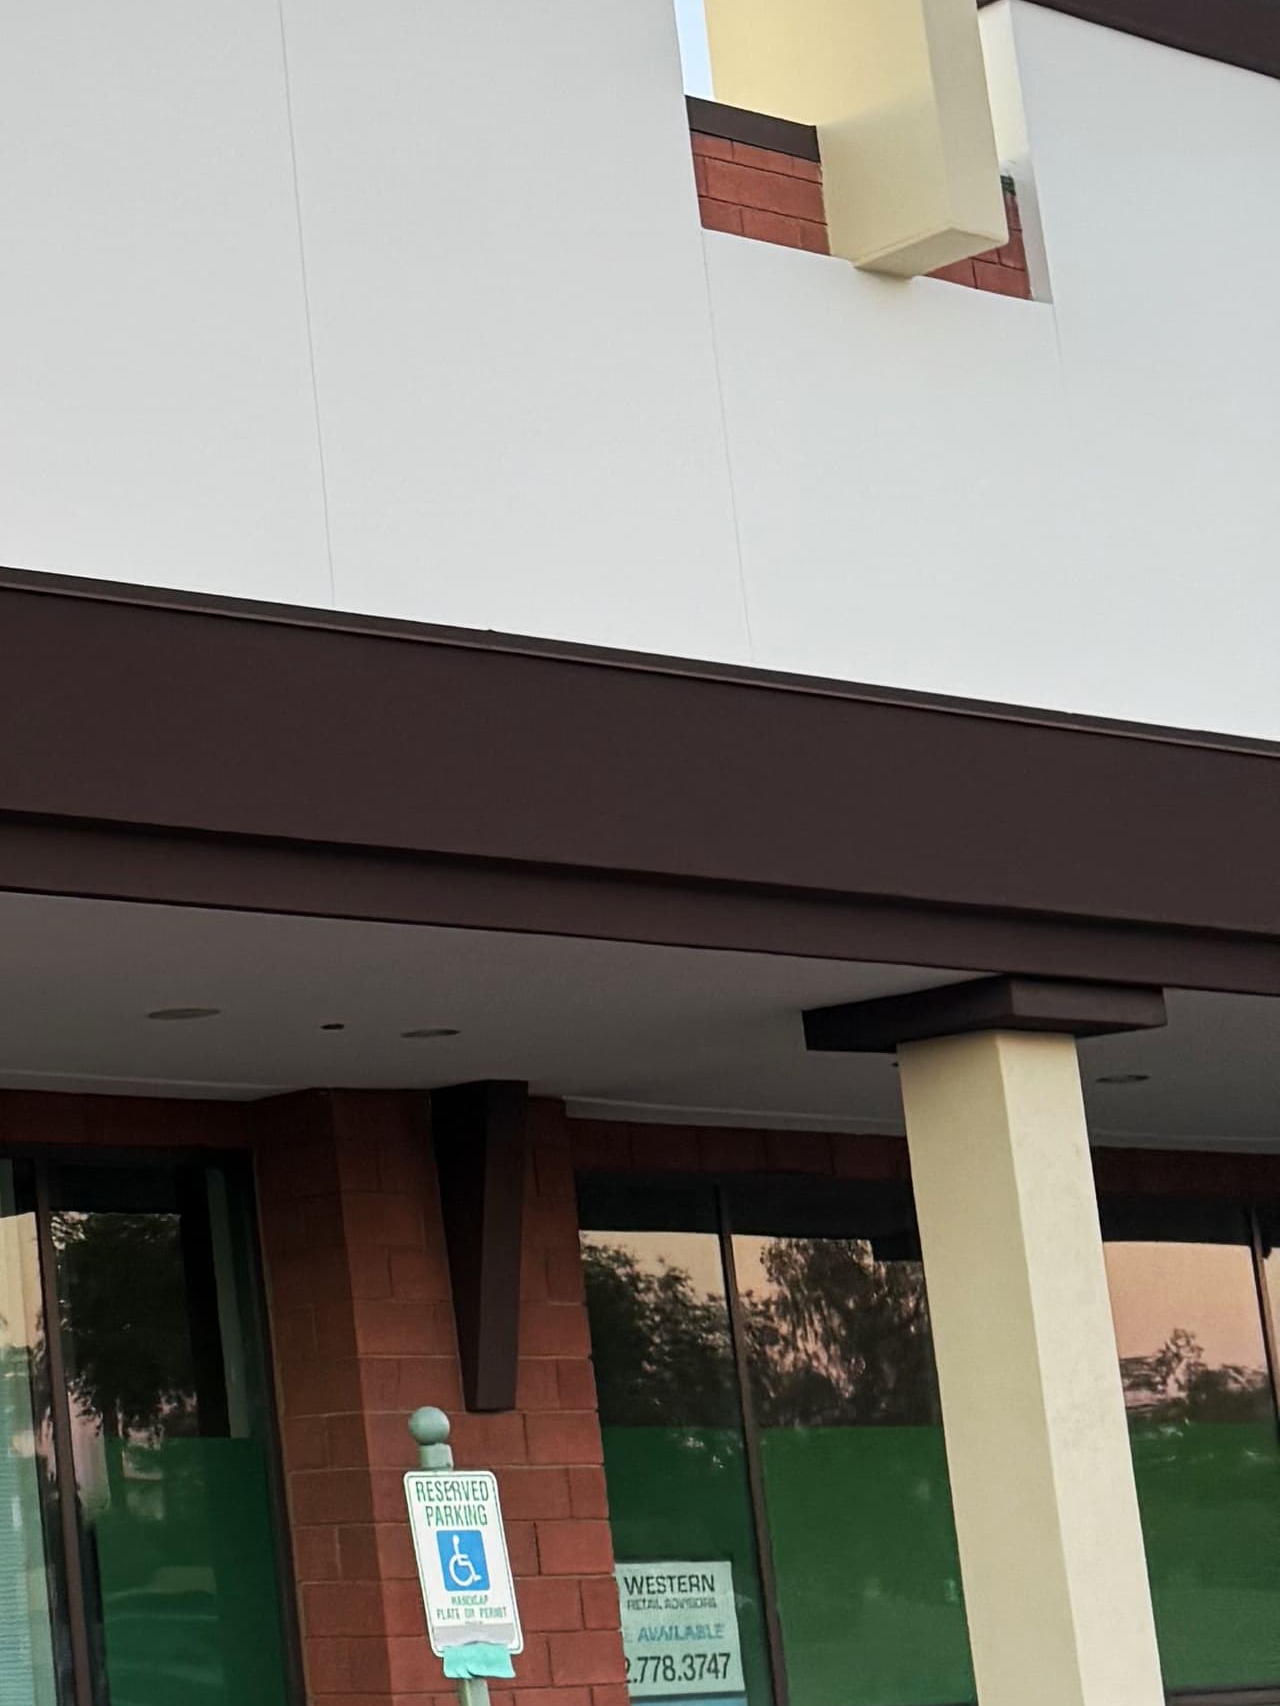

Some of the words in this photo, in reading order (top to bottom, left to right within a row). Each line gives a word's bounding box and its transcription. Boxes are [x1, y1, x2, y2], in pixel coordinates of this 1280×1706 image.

[415, 1480, 489, 1502] RESERVED
[425, 1504, 488, 1526] PARKING
[623, 1574, 715, 1595] WESTERN
[637, 1624, 725, 1642] AVAILABLE
